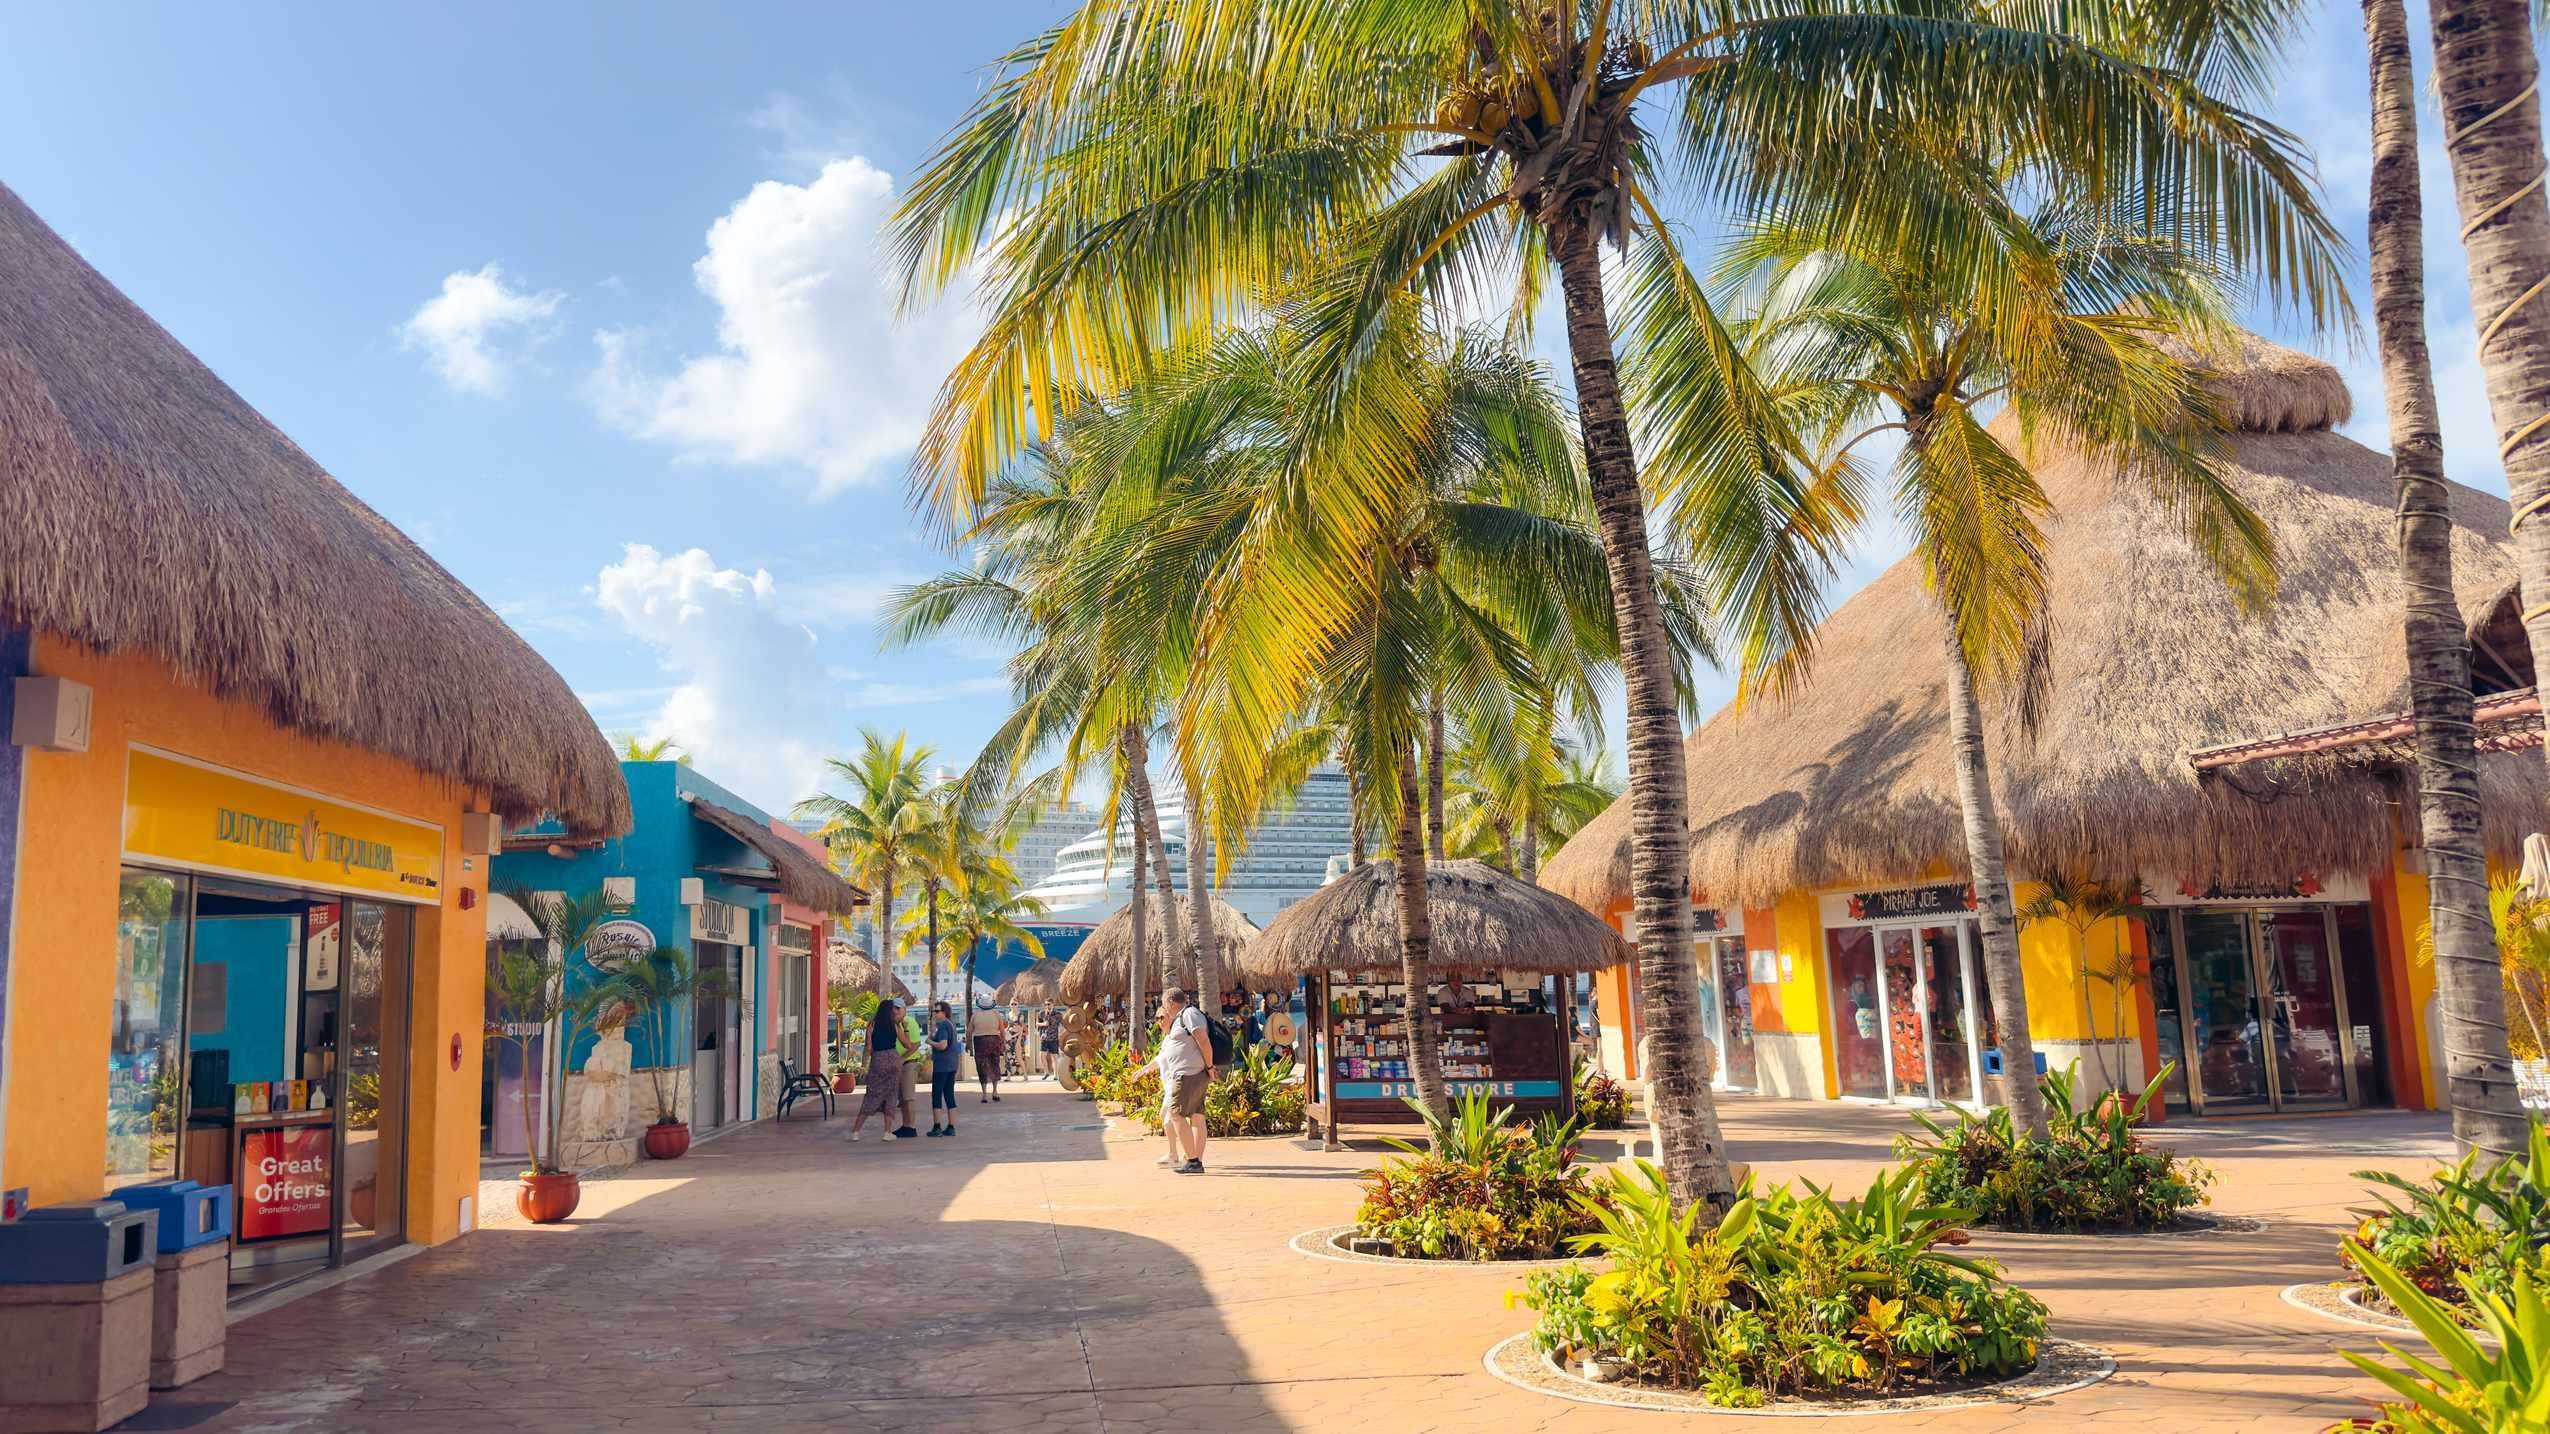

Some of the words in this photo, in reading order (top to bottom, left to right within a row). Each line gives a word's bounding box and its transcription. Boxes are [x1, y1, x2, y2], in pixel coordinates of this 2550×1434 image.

[1919, 891, 1938, 908] JOE
[309, 912, 329, 925] FREE
[1444, 1082, 1514, 1096] STORE
[260, 1155, 323, 1176] Great
[254, 1181, 326, 1203] Offers
